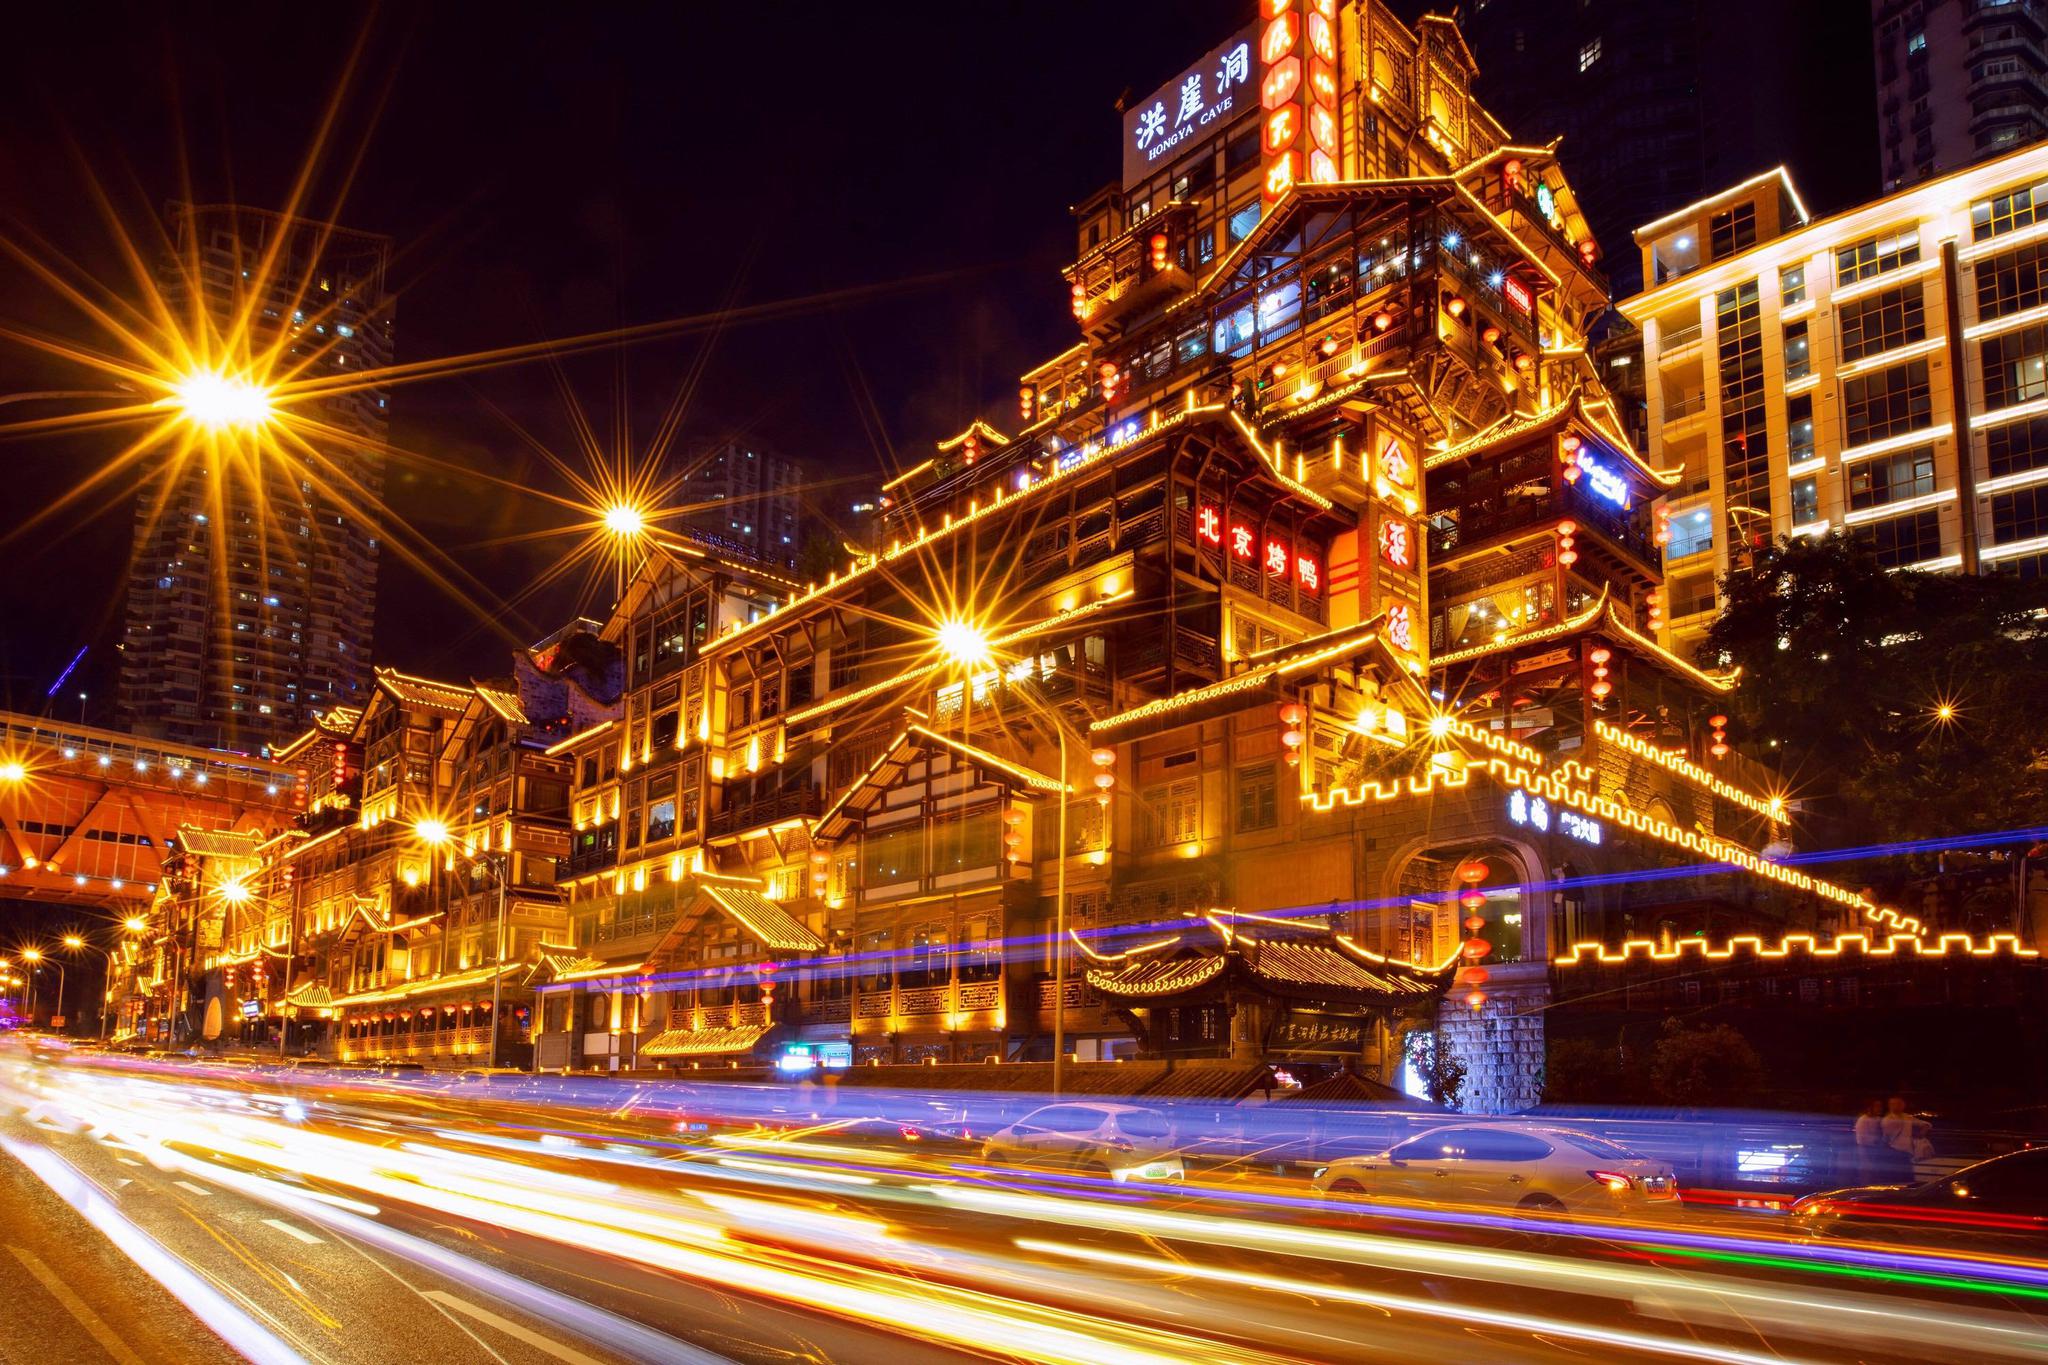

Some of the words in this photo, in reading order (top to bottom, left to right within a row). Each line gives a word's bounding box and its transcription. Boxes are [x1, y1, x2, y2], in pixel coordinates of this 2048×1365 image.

[1135, 43, 1249, 150] 洪崖洞
[1148, 126, 1195, 161] HONGYA
[1199, 96, 1233, 125] CAVE
[1199, 507, 1318, 589] 北京烤鸭
[1381, 439, 1411, 652] 全聚德
